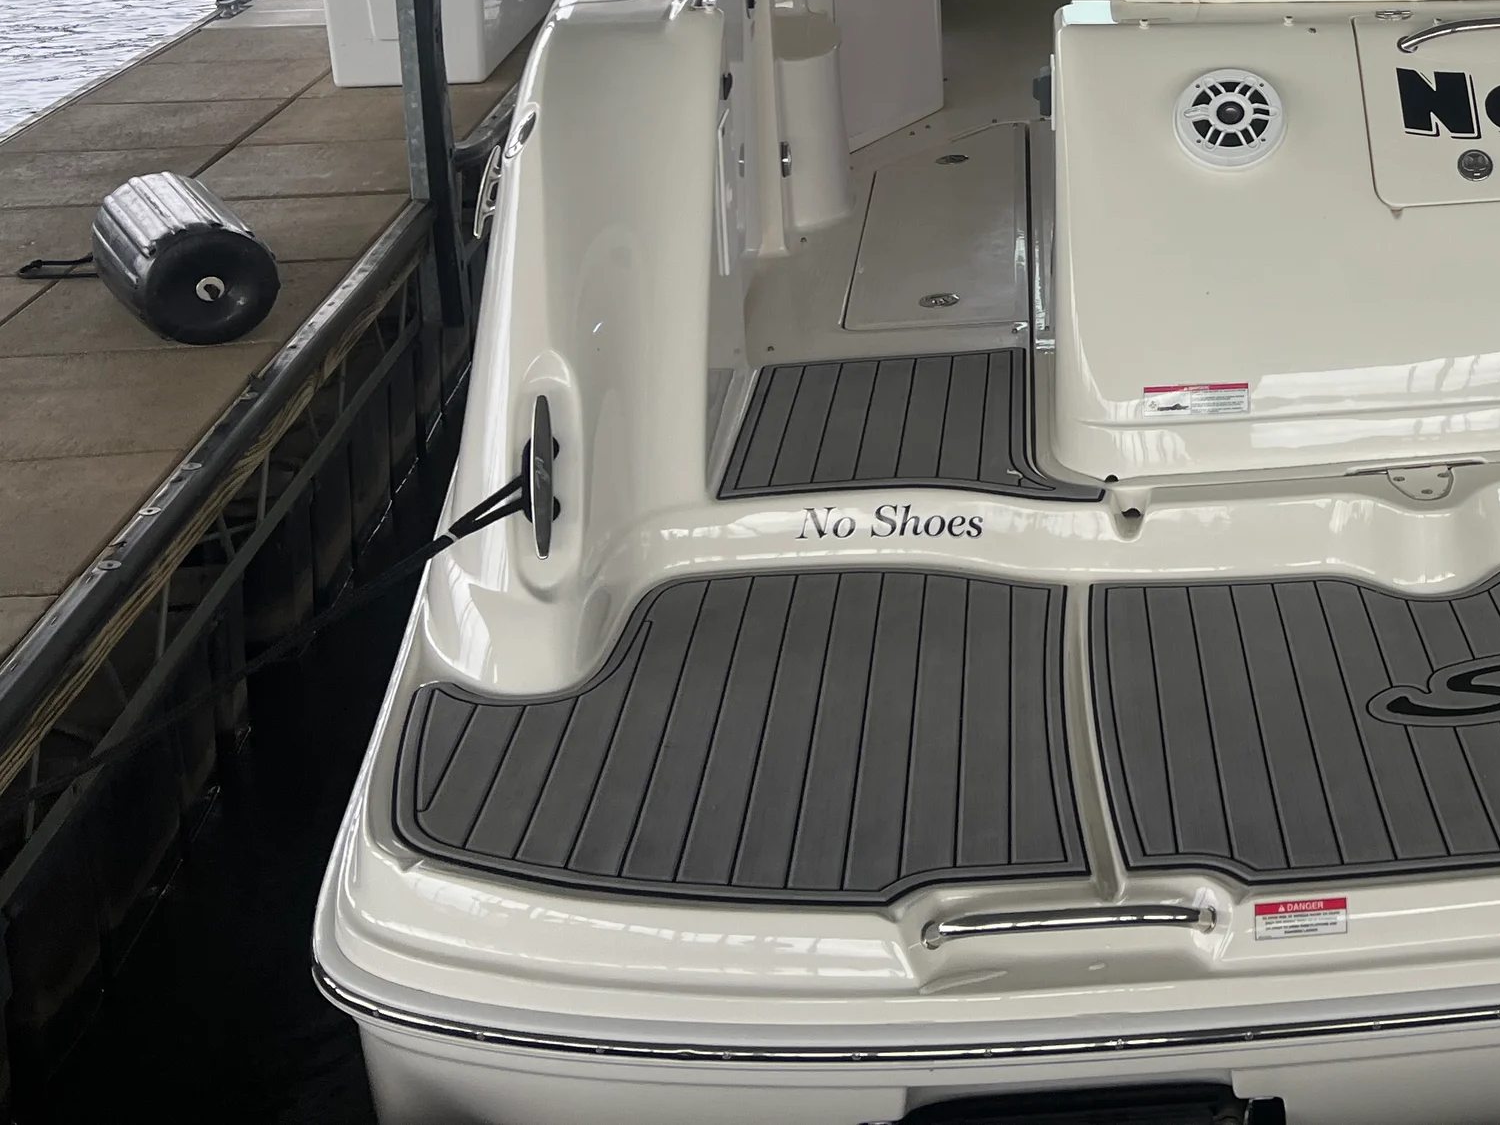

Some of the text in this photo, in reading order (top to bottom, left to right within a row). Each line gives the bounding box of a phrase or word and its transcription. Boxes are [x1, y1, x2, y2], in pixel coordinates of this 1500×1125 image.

[795, 503, 984, 540] No Shoes
[1286, 901, 1324, 912] DANGER
